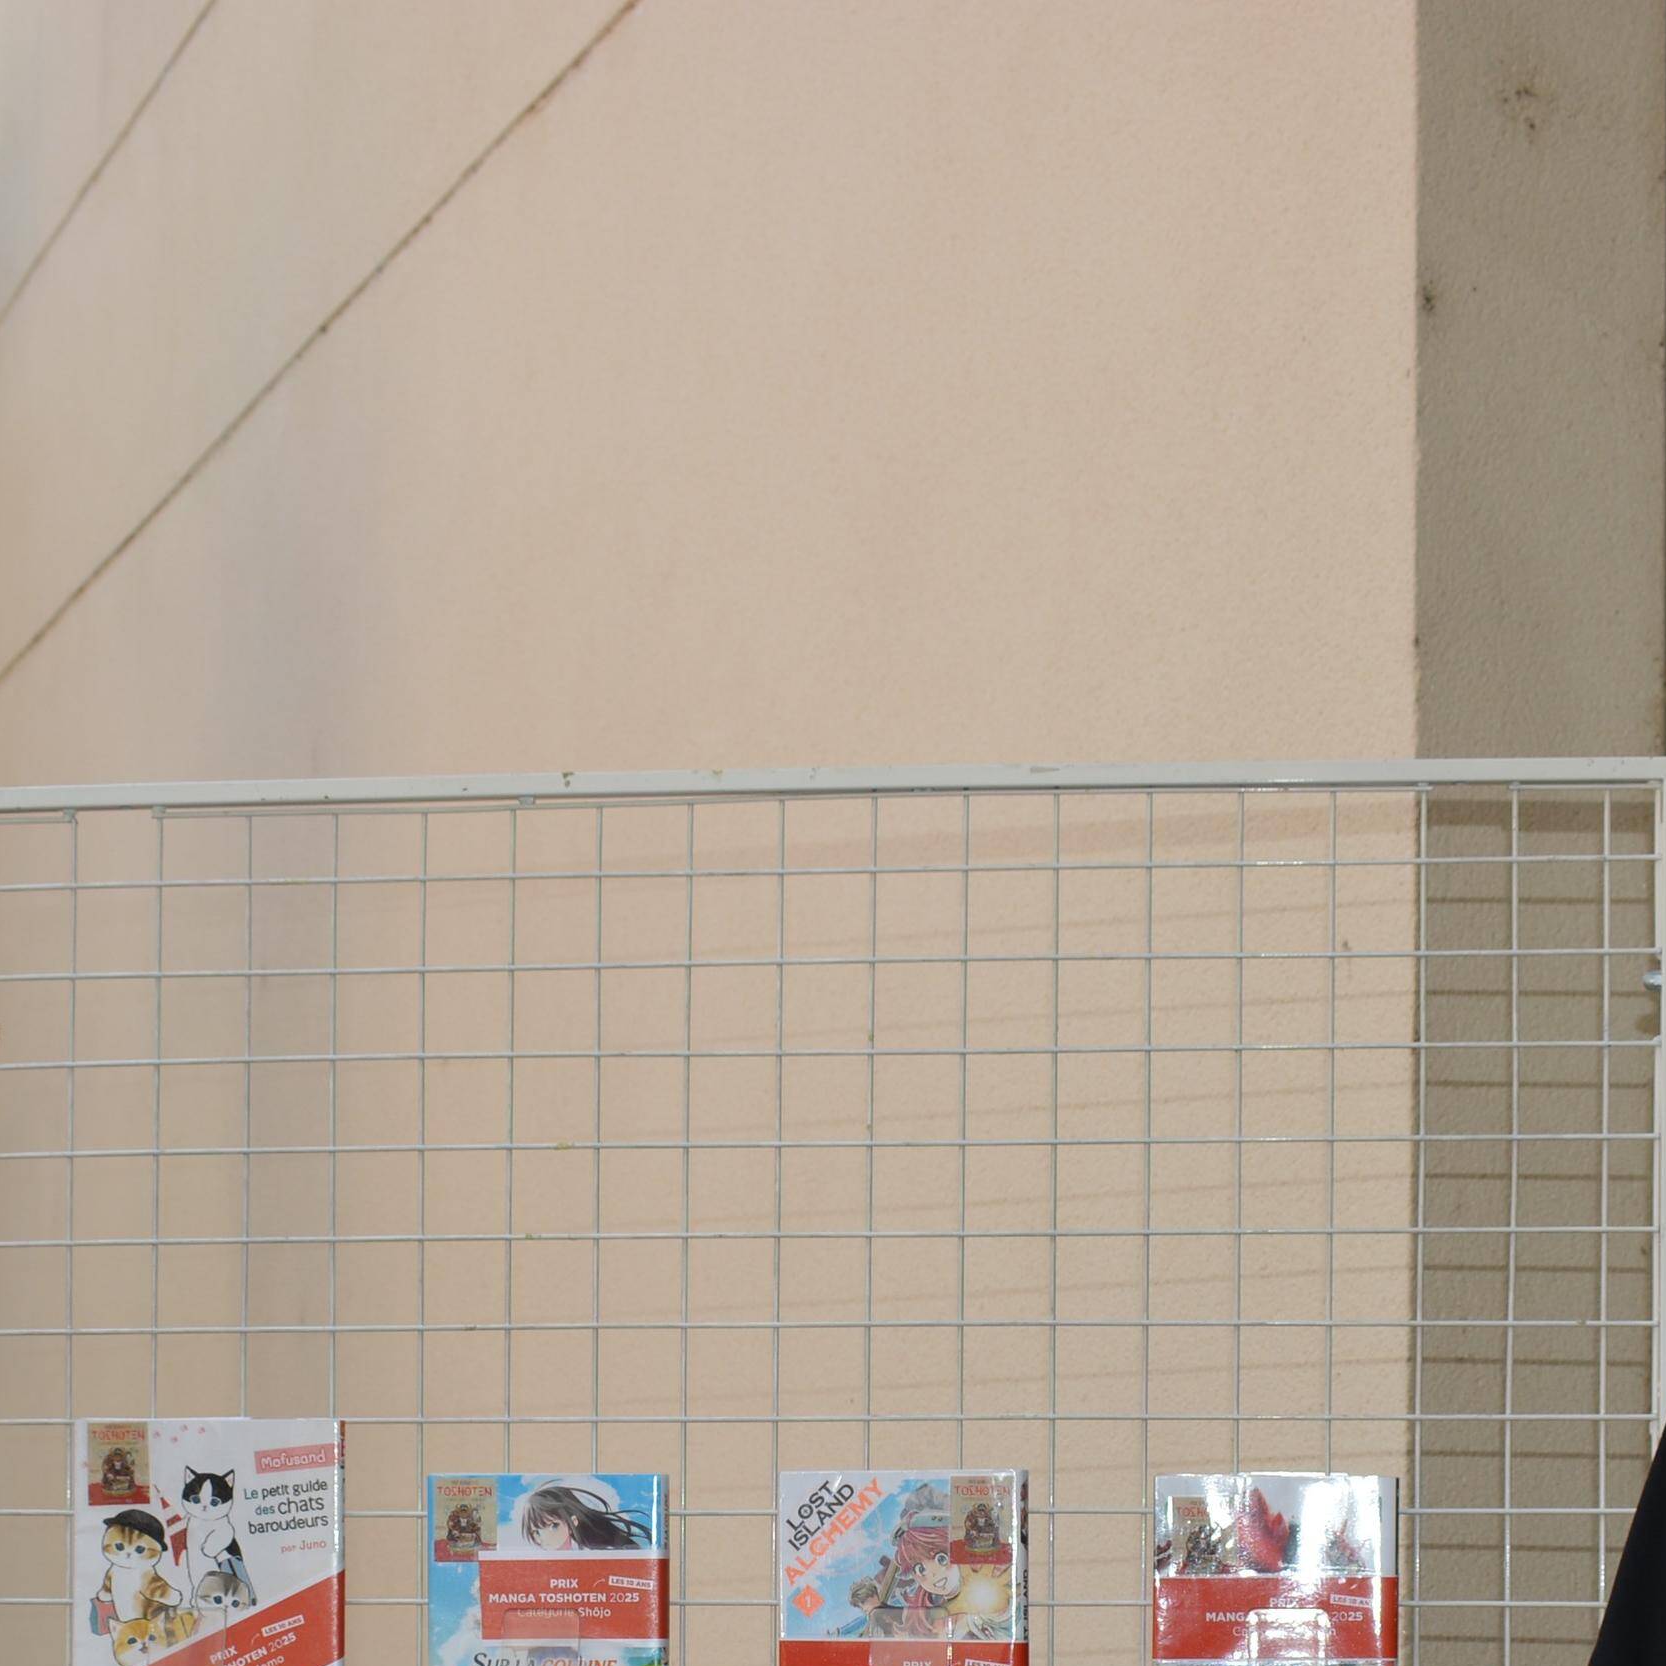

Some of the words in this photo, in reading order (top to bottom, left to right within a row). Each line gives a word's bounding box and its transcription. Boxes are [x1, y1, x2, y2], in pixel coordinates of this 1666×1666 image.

[261, 1448, 326, 1469] Mofusand
[243, 1488, 258, 1500] Le
[261, 1484, 289, 1500] petit
[293, 1479, 328, 1496] guide
[255, 1505, 275, 1516] des
[277, 1496, 325, 1515] chats
[785, 1480, 834, 1532] LOST
[248, 1515, 329, 1535] baroudeurs
[788, 1484, 854, 1552] ISLAND
[784, 1476, 884, 1586] ALCHEMY
[280, 1544, 295, 1553] par
[299, 1540, 327, 1551] Juno
[550, 1578, 579, 1589] PRIX
[635, 1579, 652, 1589] ANS
[489, 1593, 535, 1604] MANGA
[539, 1592, 607, 1603] TOSHOTEN
[609, 1592, 640, 1603] 2025
[577, 1606, 611, 1619] Shôjo
[1333, 1611, 1363, 1622] 2025
[268, 1632, 297, 1653] 2025
[209, 1645, 238, 1665] PRIX
